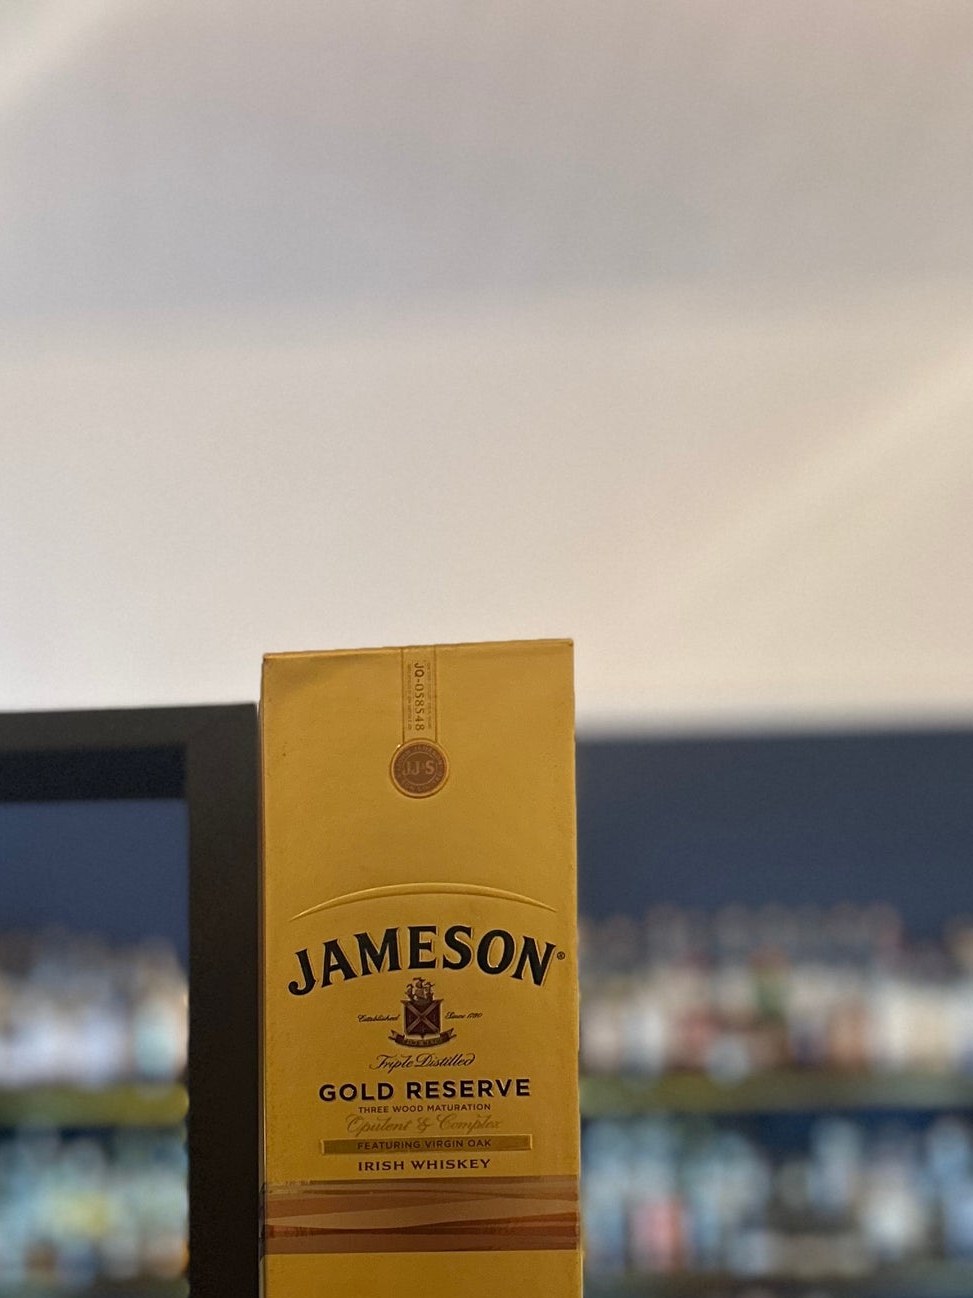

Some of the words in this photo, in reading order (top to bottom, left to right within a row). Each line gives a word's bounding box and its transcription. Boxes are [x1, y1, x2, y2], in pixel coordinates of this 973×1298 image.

[414, 662, 425, 731] JQ-058548
[288, 925, 557, 996] JAMESON
[369, 1054, 414, 1074] Triple
[413, 1053, 476, 1068] Distilled
[319, 1083, 394, 1102] GOLD
[406, 1078, 531, 1100] RESERVE
[358, 1106, 390, 1114] THREE
[392, 1105, 424, 1113] WOOD
[427, 1103, 491, 1112] MATURATION
[345, 1113, 411, 1137] Opulent
[435, 1113, 501, 1136] Complex
[357, 1141, 421, 1151] FEATURING
[425, 1139, 464, 1149] VIRGIN
[467, 1138, 492, 1148] OAK
[358, 1160, 405, 1172] IRISH
[411, 1158, 491, 1171] WHISKEY
